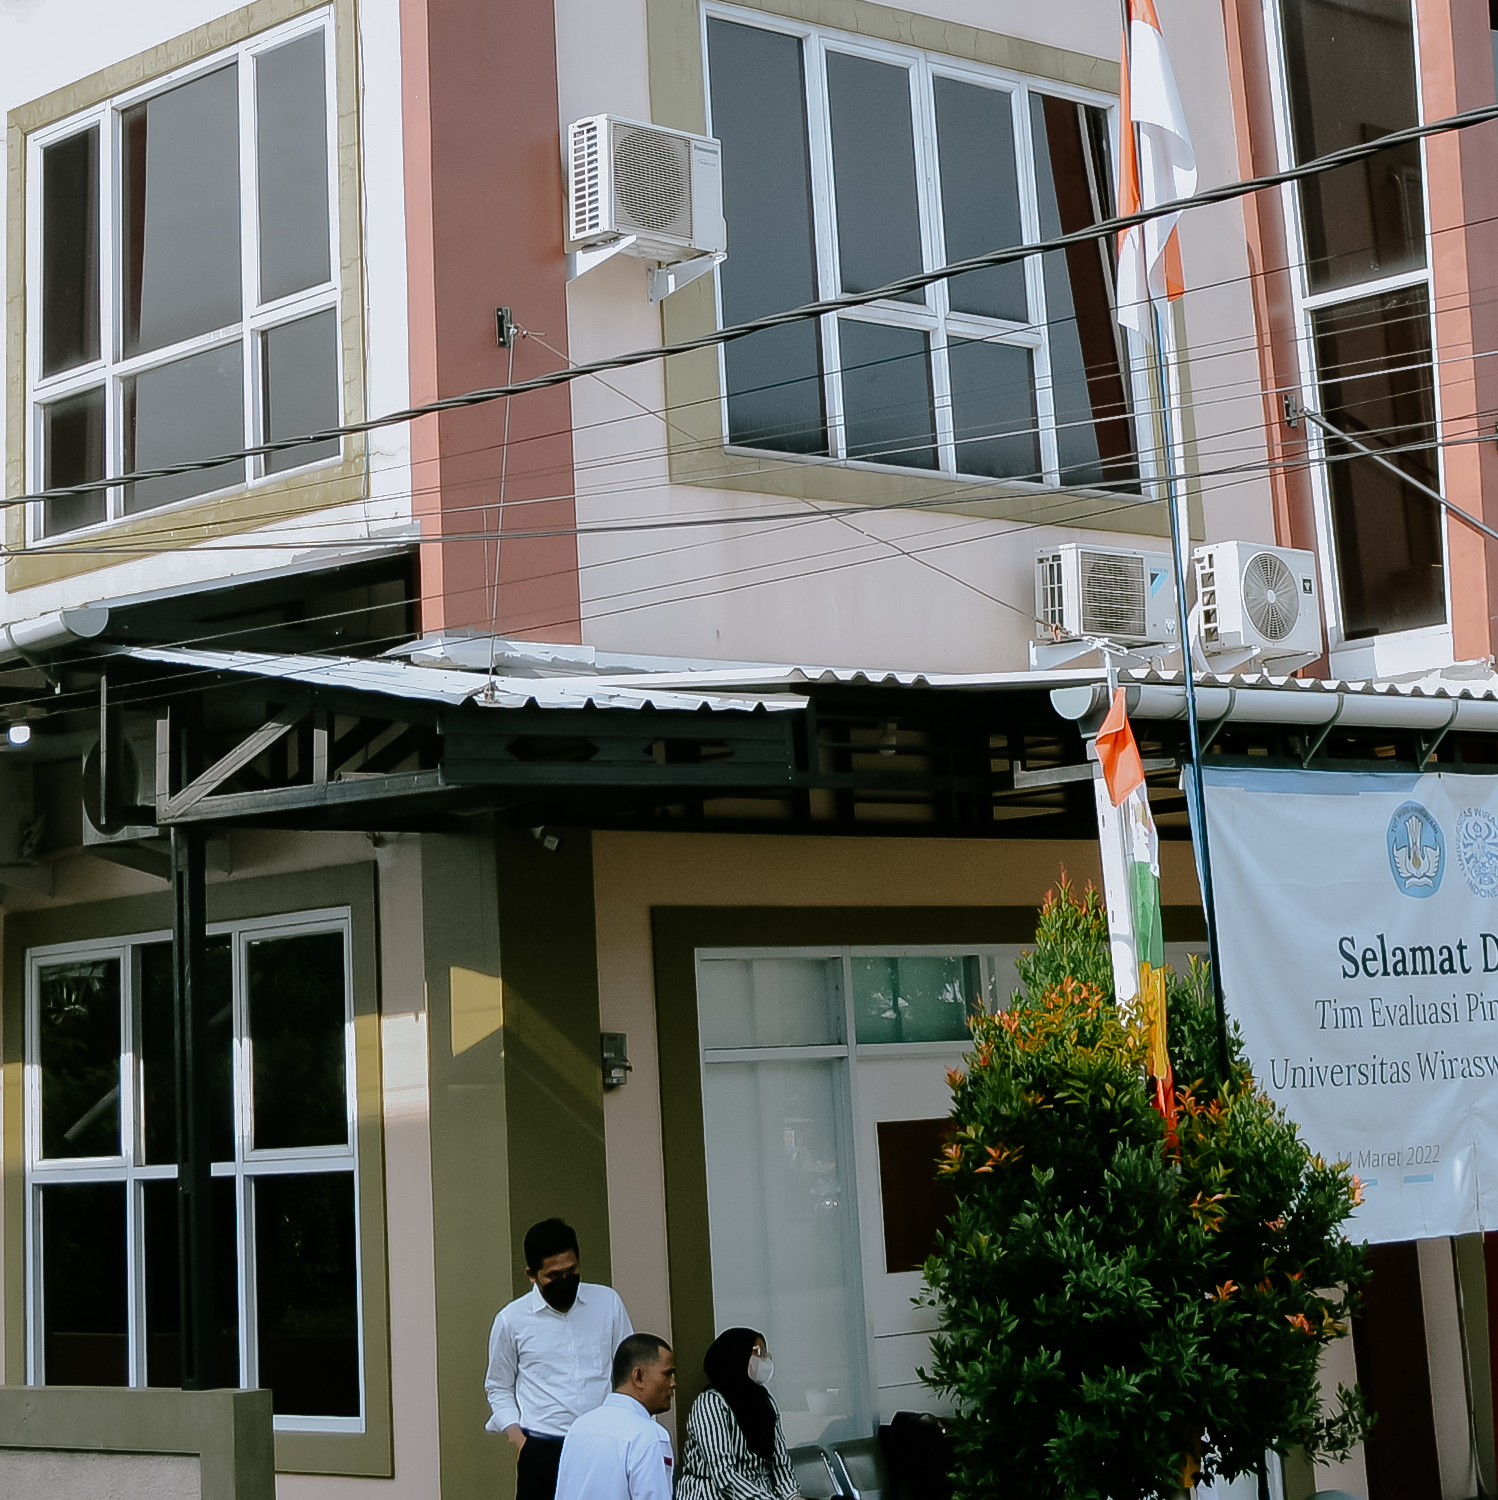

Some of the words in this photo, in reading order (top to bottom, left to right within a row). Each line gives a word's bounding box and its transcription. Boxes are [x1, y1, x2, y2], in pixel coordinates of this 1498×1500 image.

[1338, 933, 1473, 979] Selamat
[1314, 998, 1364, 1030] Tim
[1369, 993, 1460, 1028] Evaluasi
[1269, 1055, 1411, 1090] Universitas
[1357, 1149, 1402, 1169] Maret
[1406, 1145, 1440, 1166] 2022
